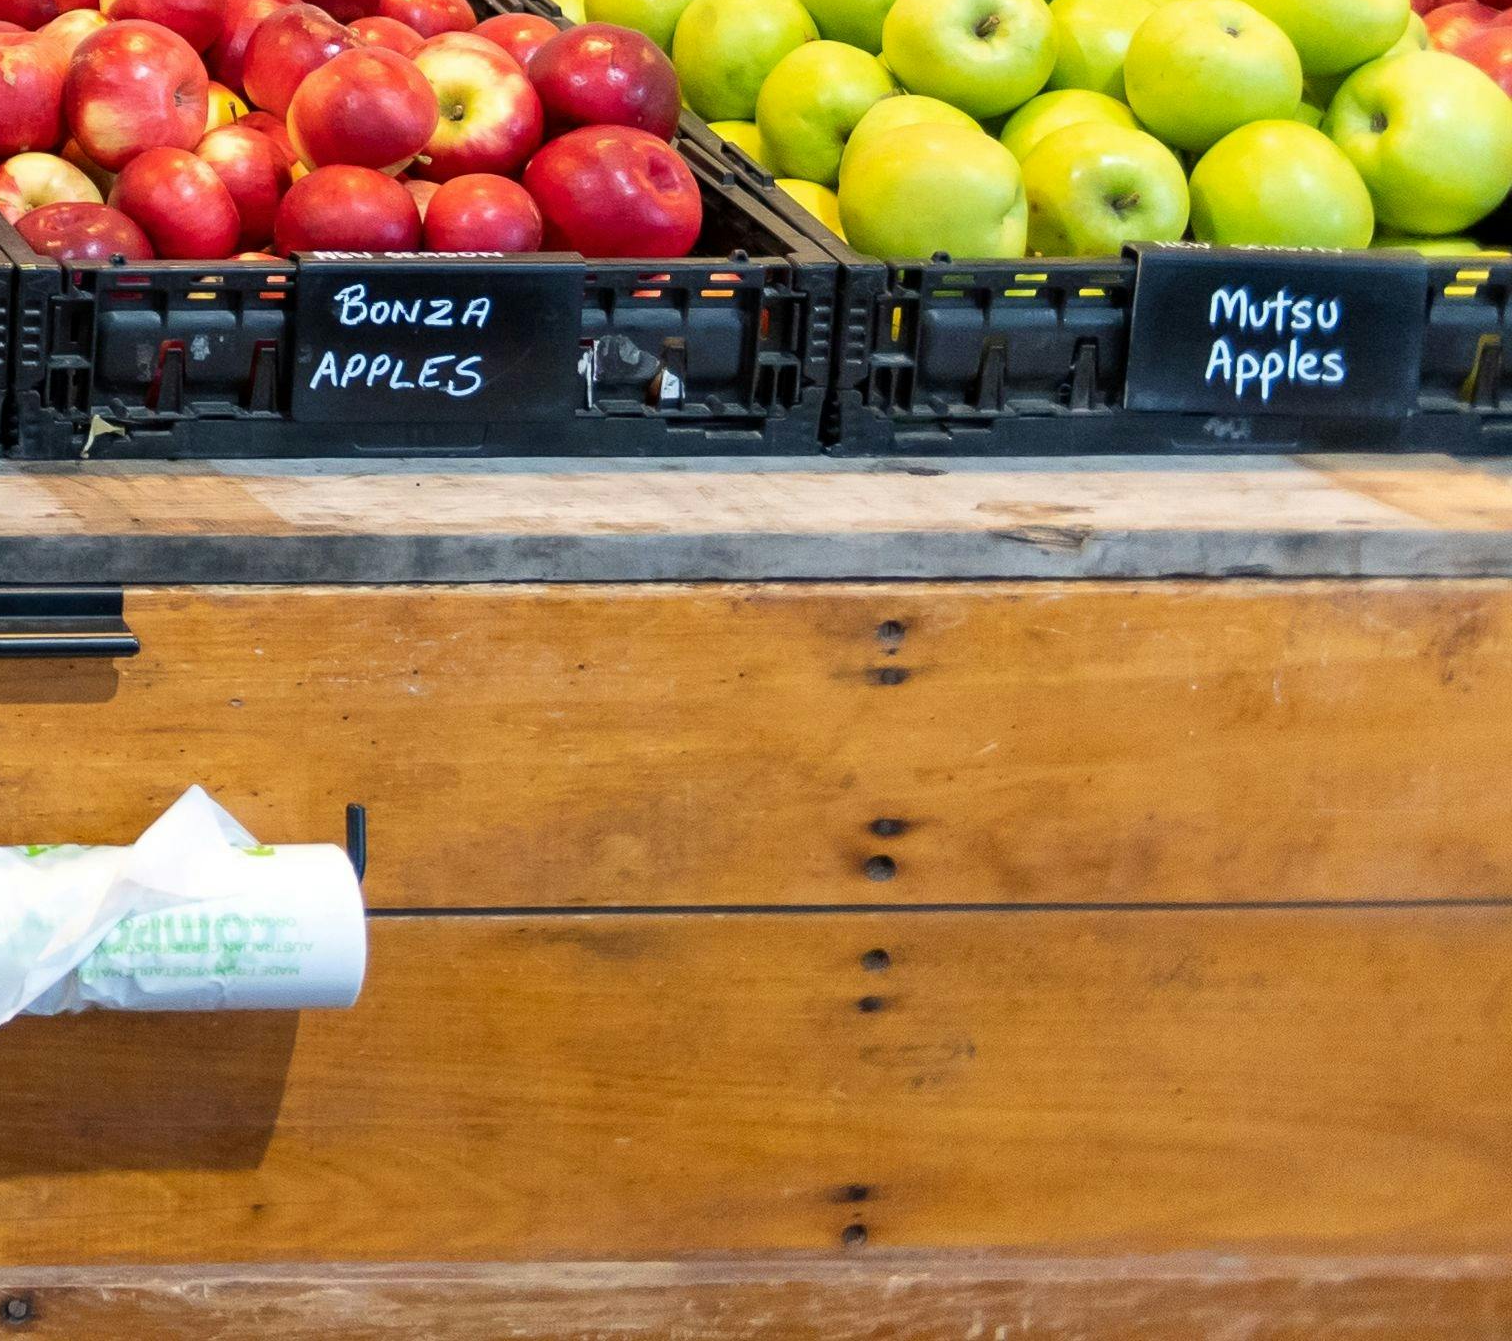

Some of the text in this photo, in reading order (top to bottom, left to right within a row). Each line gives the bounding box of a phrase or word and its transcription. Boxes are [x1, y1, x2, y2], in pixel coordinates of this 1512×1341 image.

[334, 283, 492, 329] BONZA
[1208, 287, 1340, 333] Mutsu
[309, 350, 483, 398] APPLES
[1204, 335, 1346, 401] Apples
